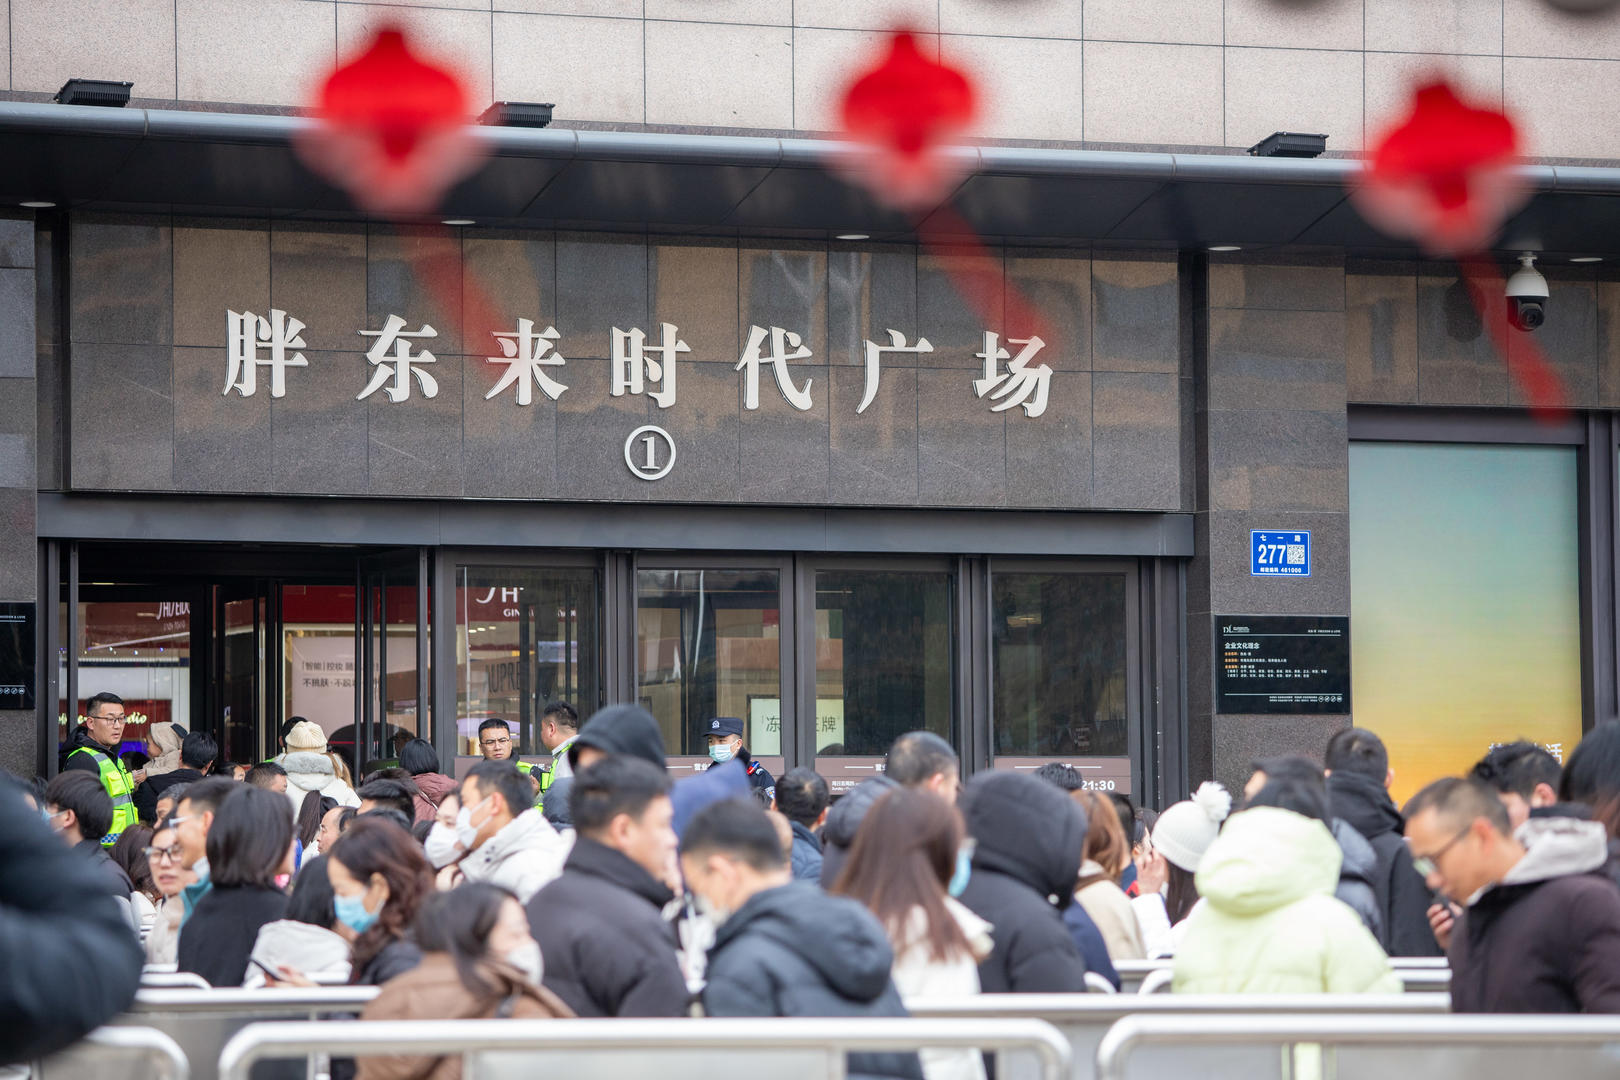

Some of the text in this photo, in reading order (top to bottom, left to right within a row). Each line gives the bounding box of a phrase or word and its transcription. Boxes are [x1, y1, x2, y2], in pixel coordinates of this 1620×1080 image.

[222, 308, 1054, 418] 胖东来时代广场
[1258, 544, 1286, 564] 277
[1081, 780, 1116, 791] 21:30
